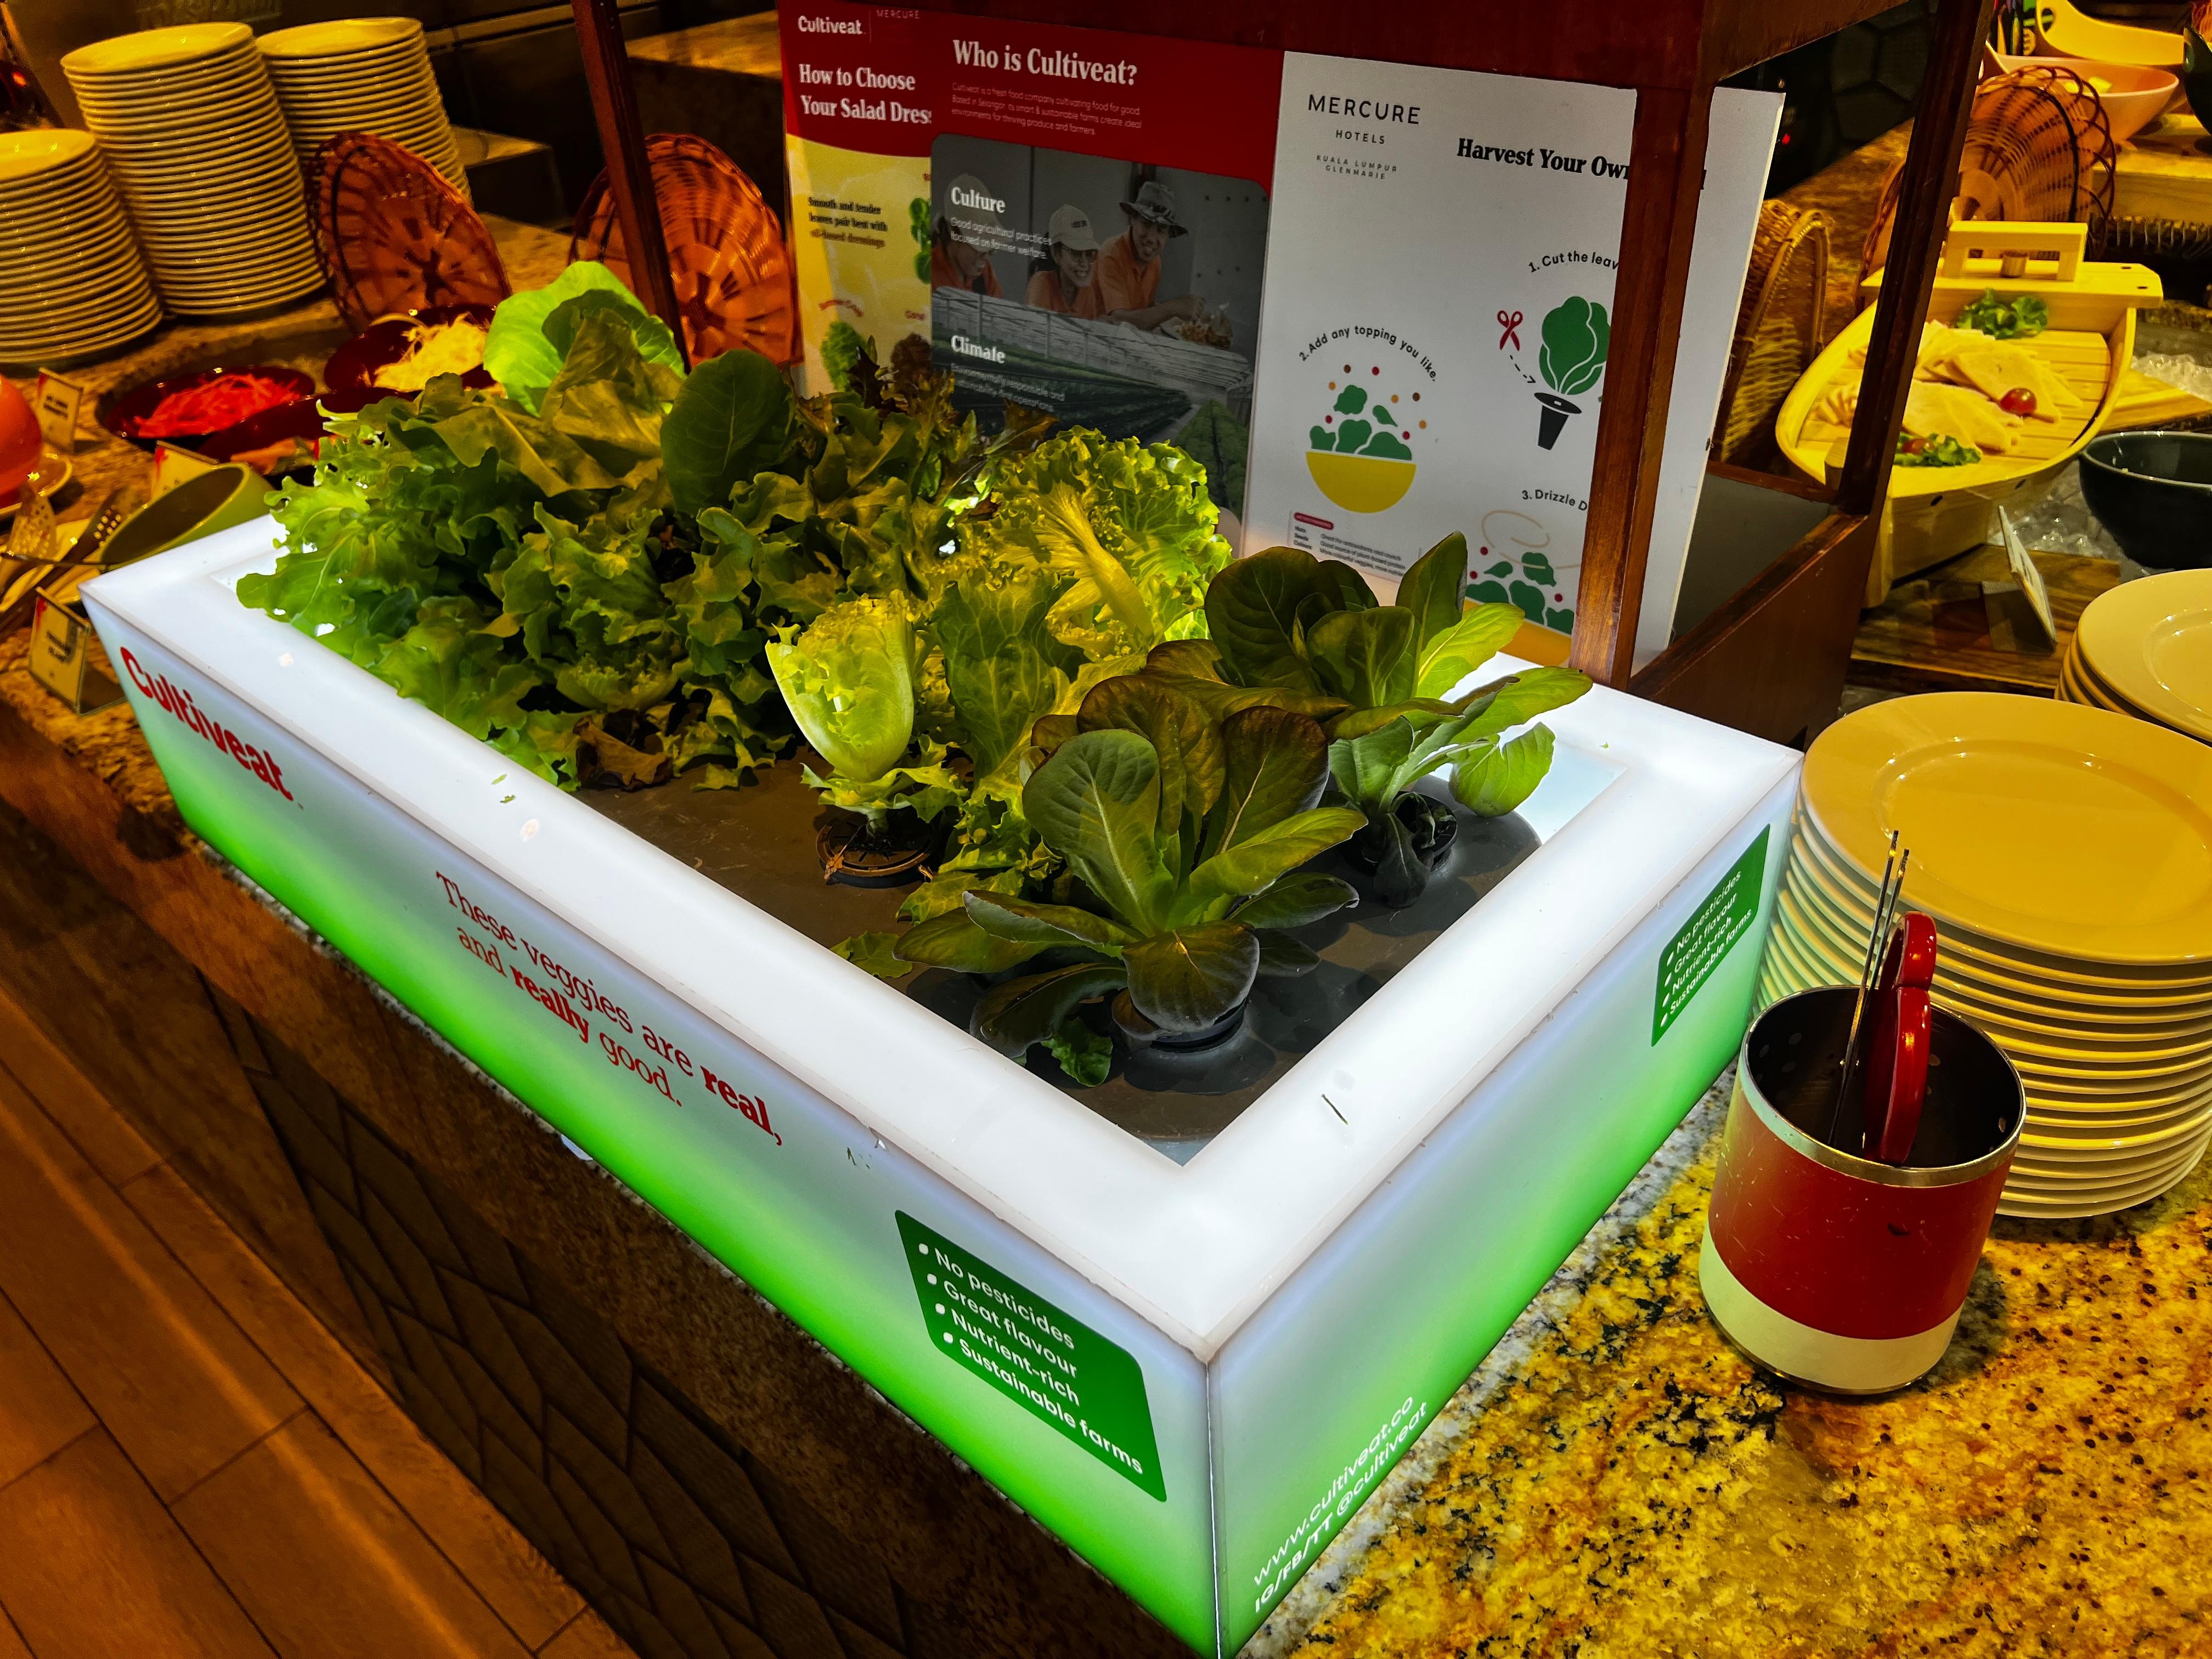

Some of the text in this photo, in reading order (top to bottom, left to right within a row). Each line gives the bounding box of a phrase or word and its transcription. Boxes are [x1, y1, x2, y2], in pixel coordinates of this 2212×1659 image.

[799, 64, 916, 91] How to Choose
[952, 40, 1138, 86] Who is Cultiveat?
[800, 95, 838, 116] Your
[840, 98, 887, 121] Salad
[1308, 94, 1421, 125] MERCURE
[1335, 129, 1385, 144] HOTELS
[1317, 154, 1397, 172] KUALA LUMPUR
[1325, 165, 1386, 180] GLENMARIE
[1457, 138, 1535, 167] Harvest
[1539, 149, 1587, 174] Your
[951, 187, 1006, 213] Culture
[1528, 262, 1540, 273] 1.
[1542, 253, 1565, 267] Cut
[1567, 250, 1588, 262] the
[951, 335, 1006, 364] Climate
[1331, 328, 1350, 338] any
[1355, 325, 1397, 345] topping
[1400, 340, 1419, 358] you
[1420, 356, 1436, 382] like.
[1521, 490, 1532, 500] 3.
[1535, 489, 1576, 506] Drizzle
[1674, 892, 1738, 974] Great flavour
[1676, 870, 1742, 955] No pesticides
[1670, 908, 1752, 1015] Sustainable farms
[1672, 917, 1732, 996] Nutrient-rich
[436, 870, 782, 1146] These veggies are real,
[457, 926, 682, 1107] and really good.
[934, 1246, 1075, 1351] No pesticides
[943, 1279, 1077, 1379] Great flavour
[951, 1307, 1080, 1407] Nutrient-rich
[959, 1338, 1144, 1475] Sustainable farms
[1253, 1396, 1414, 1587] www.cultiveat.co
[1255, 1401, 1427, 1613] IG/FB/TT @cultiveat
